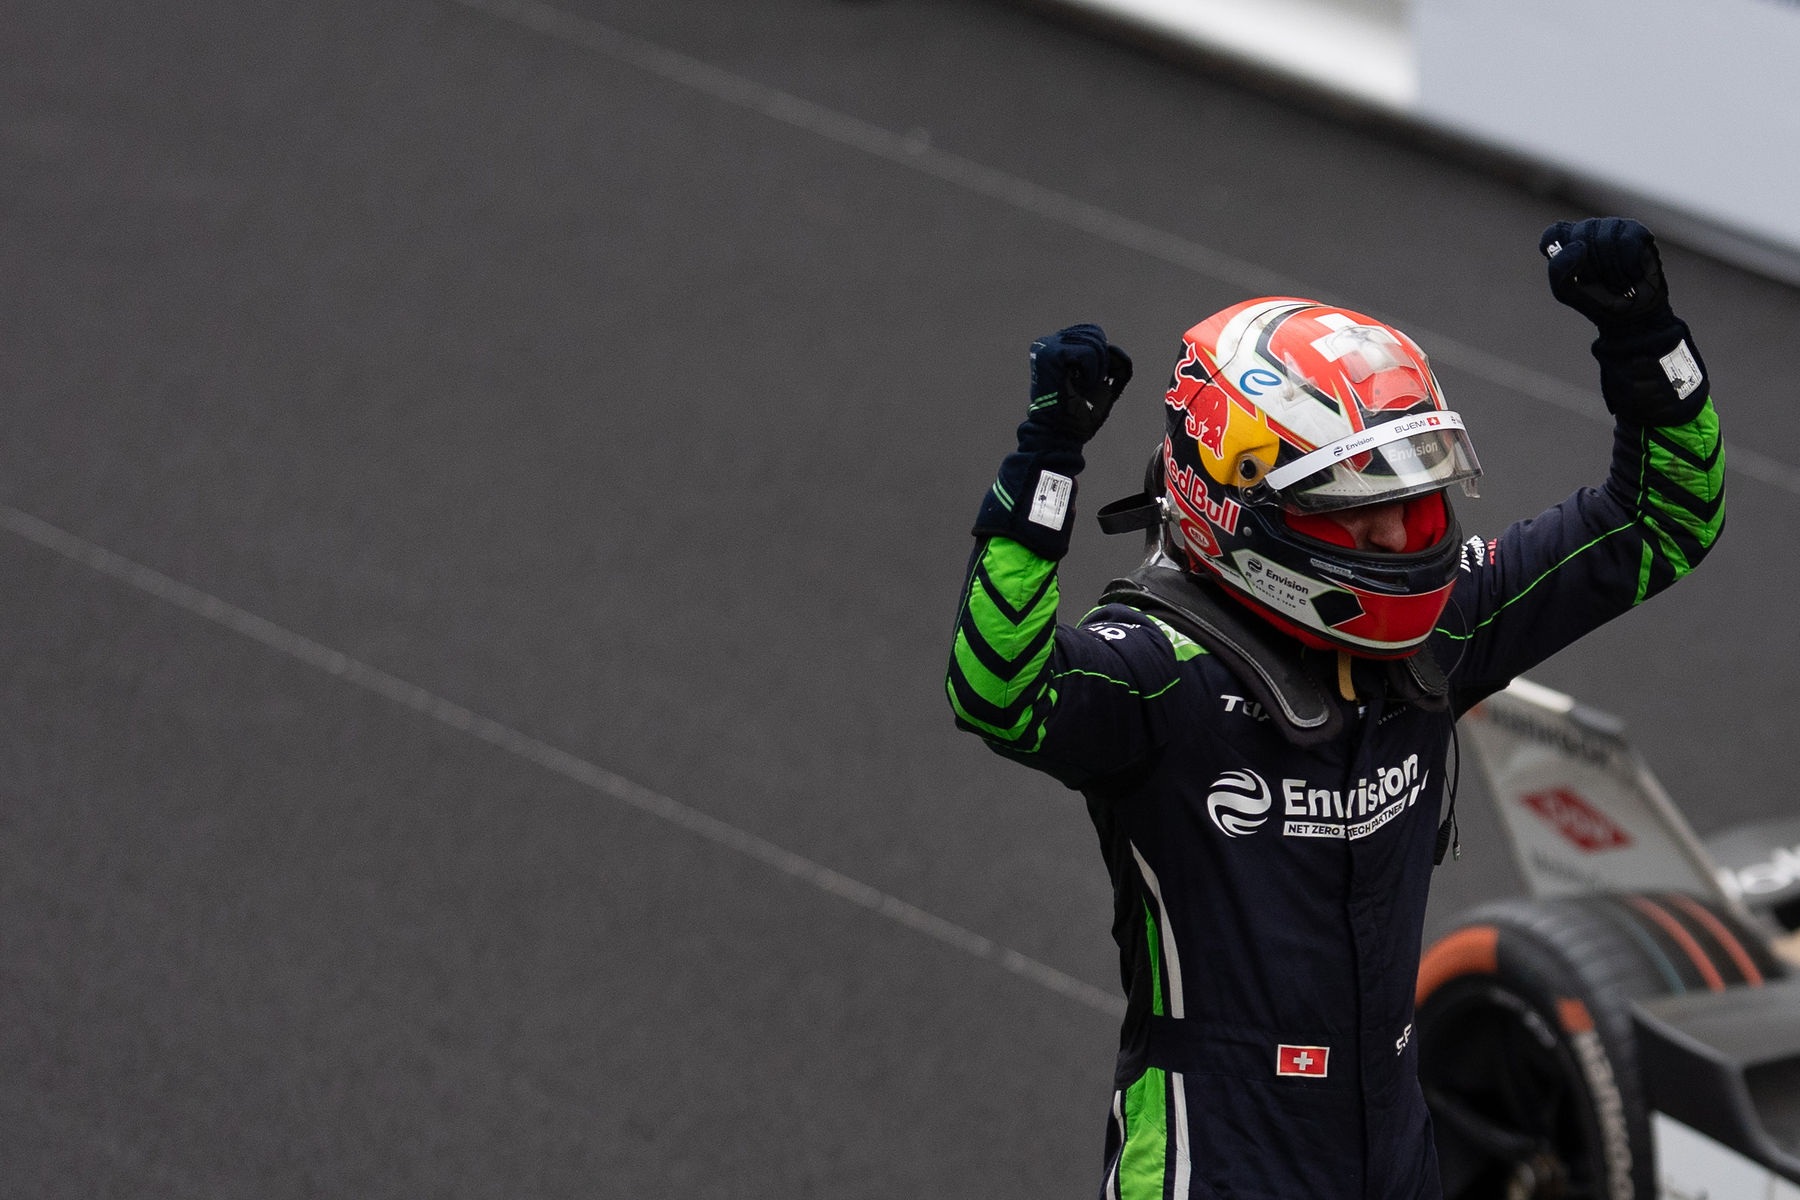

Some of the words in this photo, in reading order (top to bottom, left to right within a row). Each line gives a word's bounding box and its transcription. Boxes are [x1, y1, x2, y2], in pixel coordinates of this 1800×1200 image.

[1387, 440, 1438, 461] Envision
[1266, 569, 1309, 595] Envision
[1282, 753, 1419, 819] Envision
[1288, 824, 1310, 834] NET
[1311, 825, 1341, 836] ZERO
